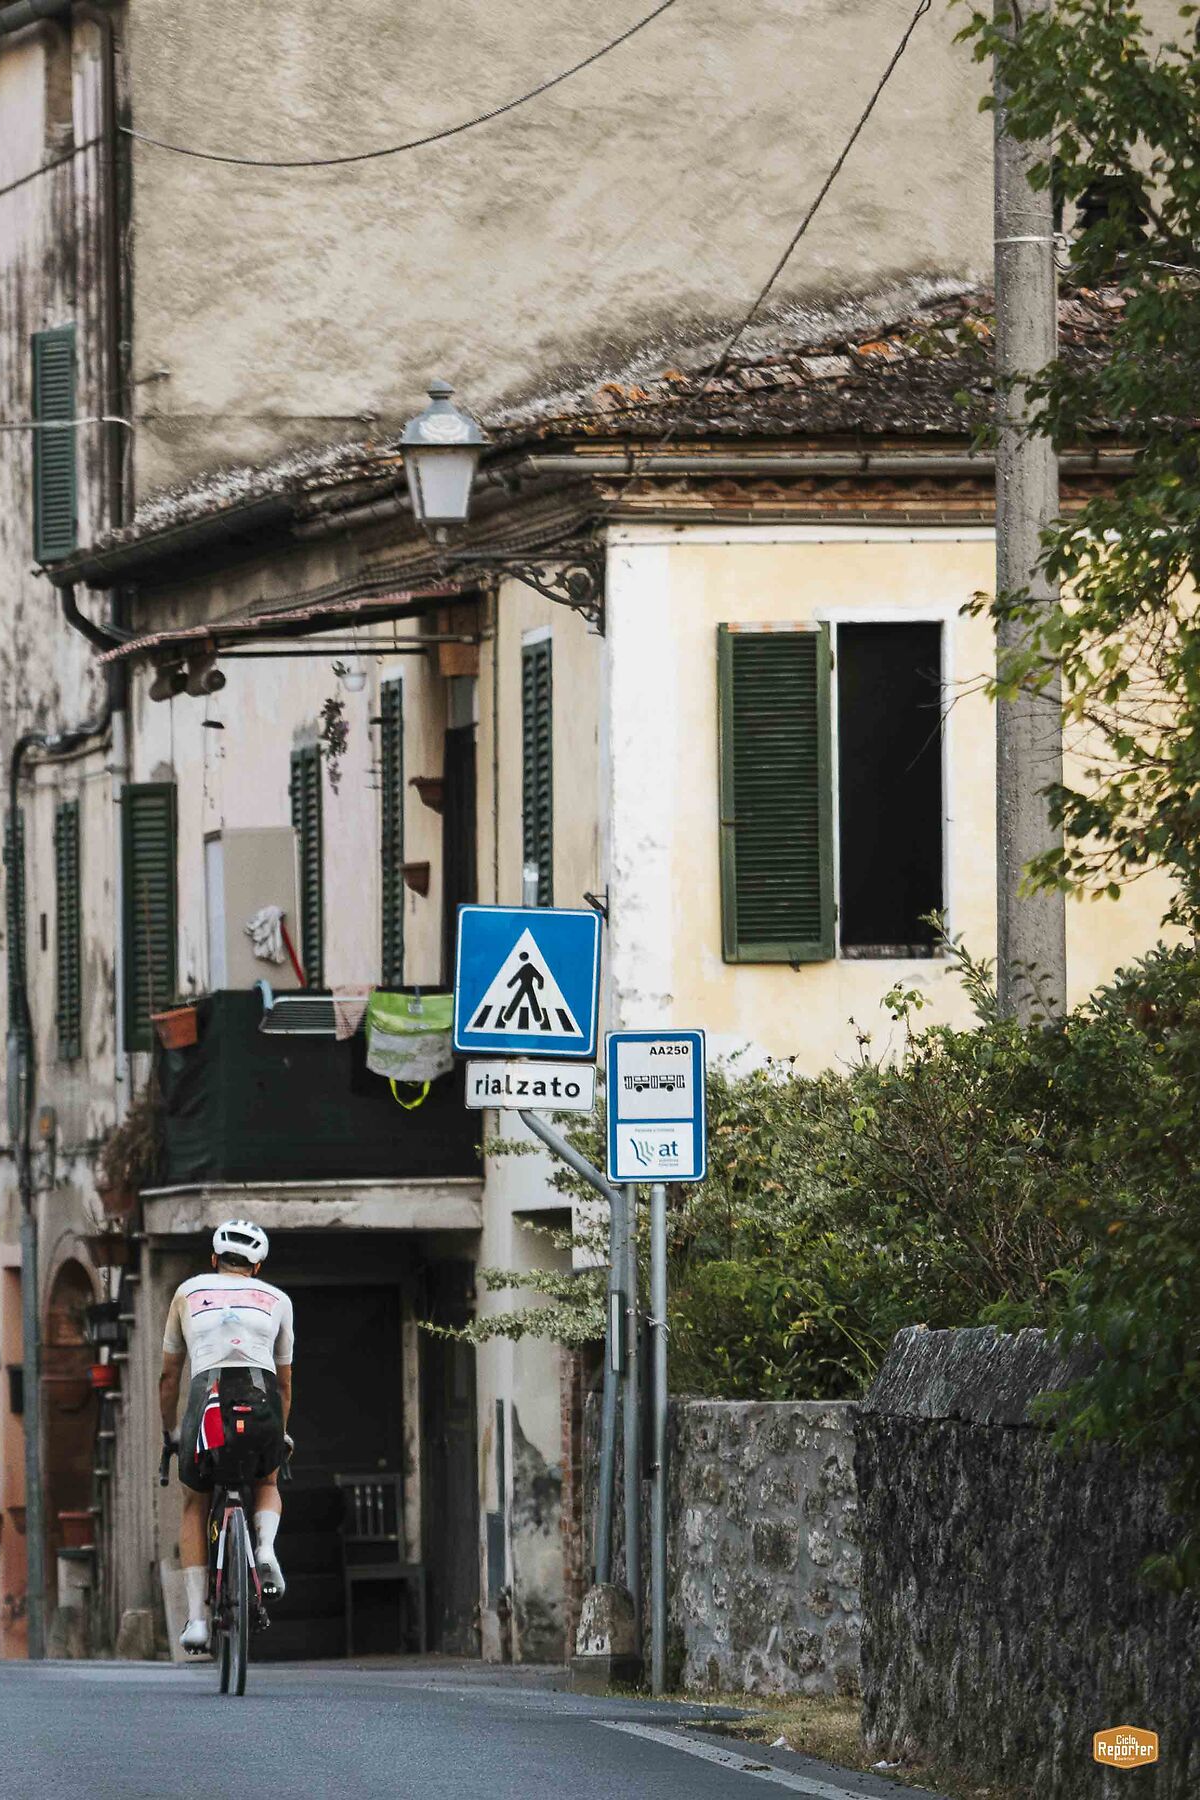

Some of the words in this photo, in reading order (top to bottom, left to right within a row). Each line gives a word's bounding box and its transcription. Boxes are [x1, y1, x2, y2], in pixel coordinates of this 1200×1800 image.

[649, 1045, 689, 1056] AA250
[475, 1073, 581, 1098] rialzato
[658, 1140, 679, 1157] at
